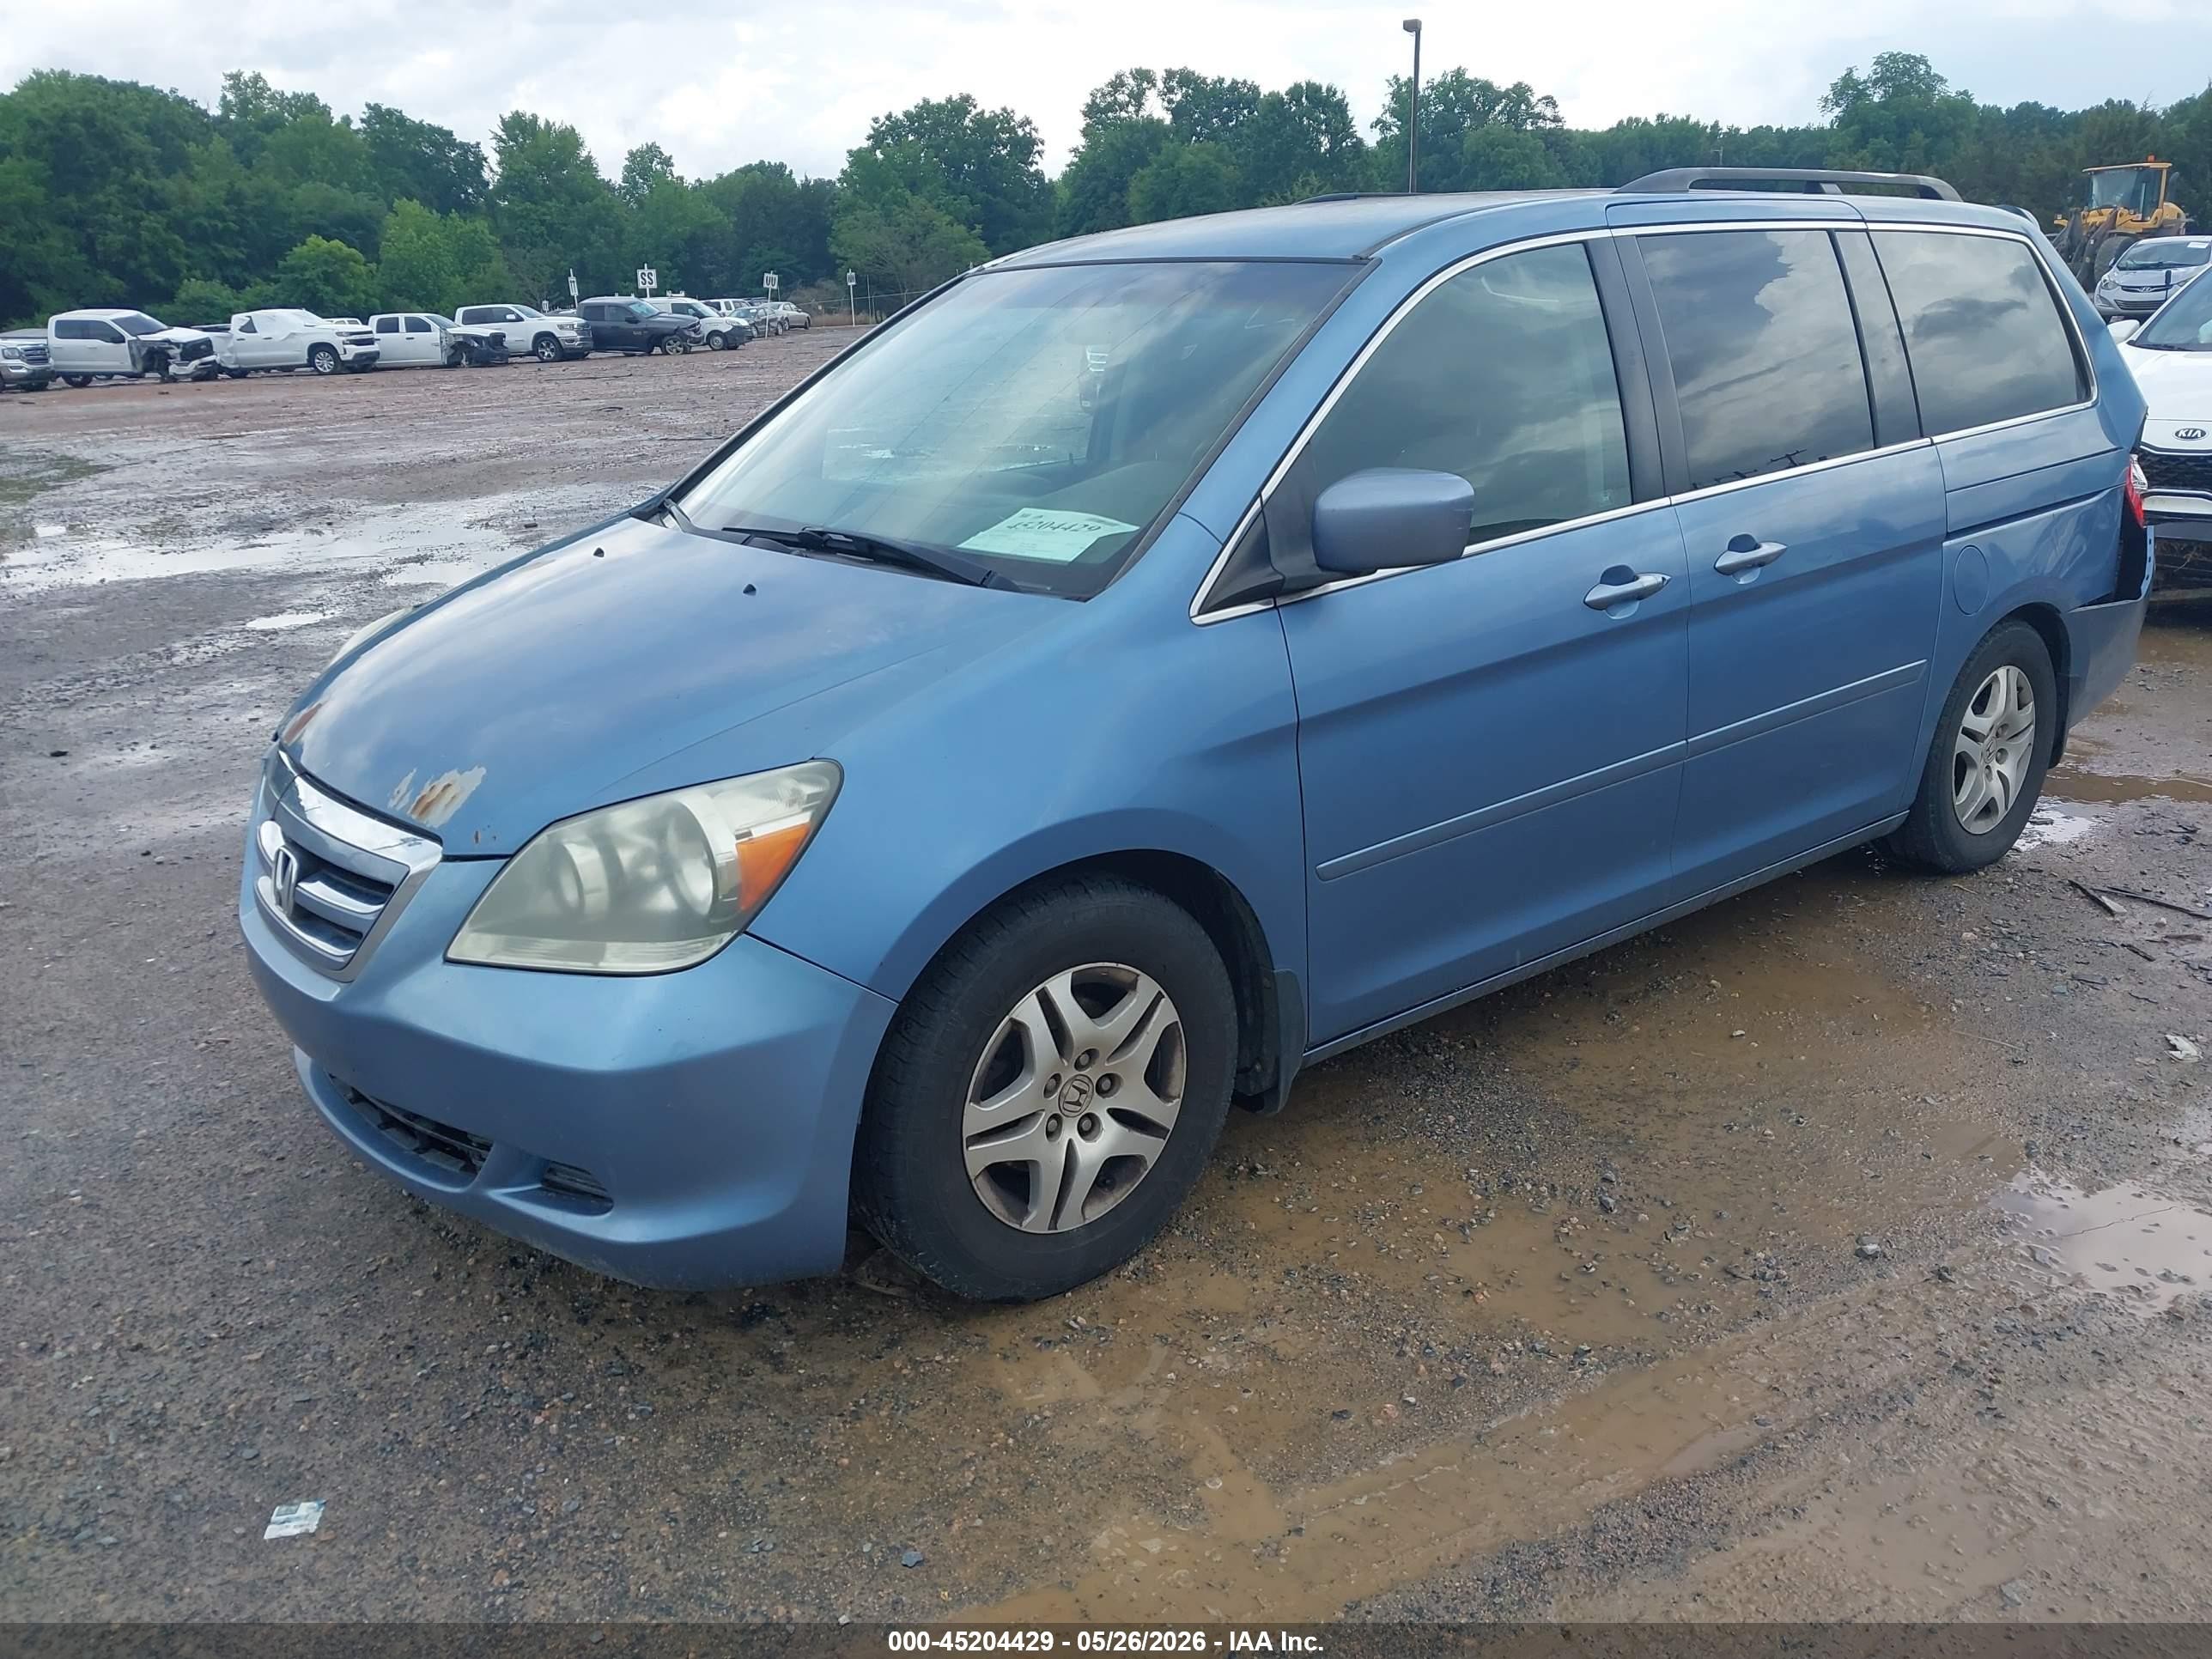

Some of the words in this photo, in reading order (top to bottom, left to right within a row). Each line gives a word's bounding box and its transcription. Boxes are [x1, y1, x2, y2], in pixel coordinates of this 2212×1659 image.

[640, 271, 653, 285] SS
[765, 275, 776, 287] UU
[2178, 428, 2202, 438] KIA
